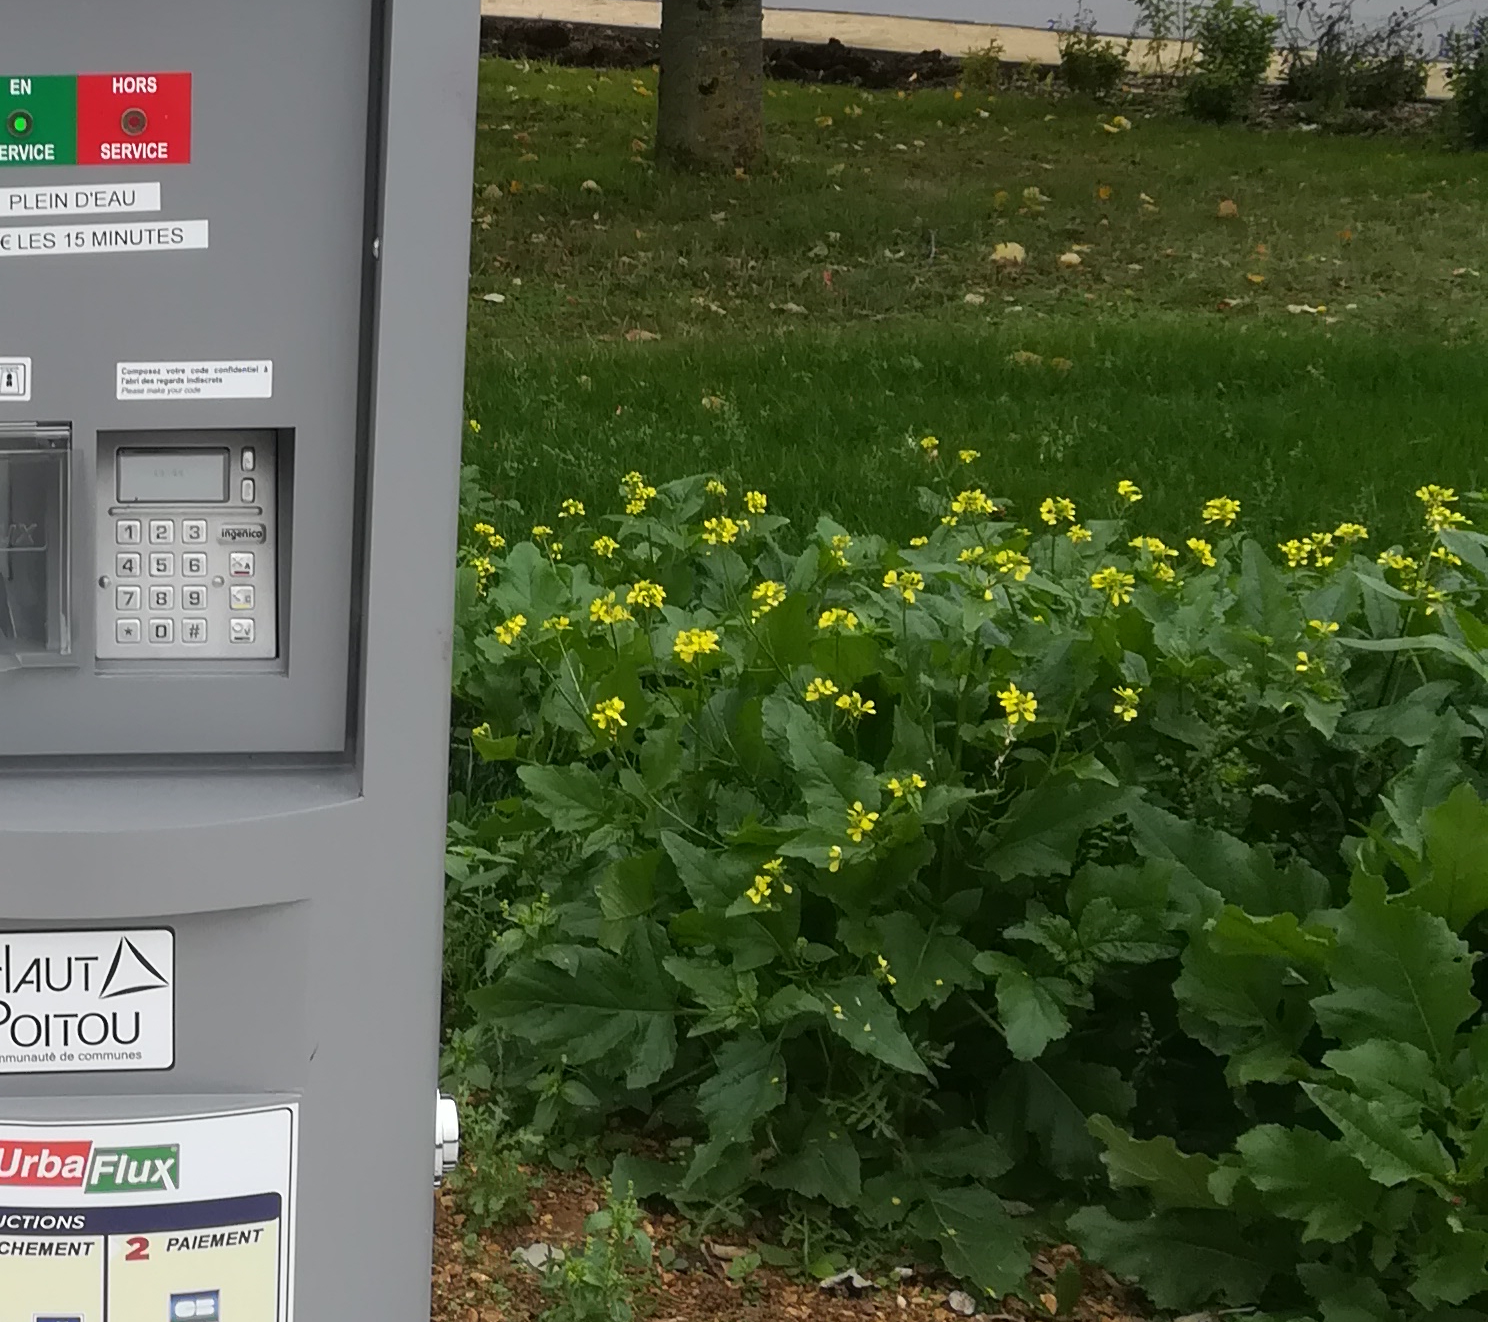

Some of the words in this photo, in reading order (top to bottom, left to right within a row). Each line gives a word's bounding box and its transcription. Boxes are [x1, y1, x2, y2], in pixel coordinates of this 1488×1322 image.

[10, 78, 31, 95] EN
[112, 77, 157, 94] HORS
[100, 142, 168, 160] SERVICE
[9, 192, 68, 210] PLEIN
[76, 190, 136, 208] D'EAU
[0, 234, 12, 251] €
[18, 232, 56, 250] LES
[64, 231, 85, 248] 15
[92, 227, 184, 247] MINUTES
[121, 367, 161, 375] Composez
[191, 366, 209, 374] code
[214, 365, 259, 374] confidentiel
[141, 377, 155, 385] des
[156, 377, 184, 386] regards
[186, 376, 223, 384] indiscrets
[124, 525, 133, 540] 1
[156, 525, 167, 540] 2
[189, 525, 200, 540] 3
[221, 528, 262, 540] ingenico
[122, 558, 133, 573] 4
[156, 558, 167, 573] 5
[189, 558, 200, 573] 6
[123, 591, 134, 606] 7
[156, 591, 167, 606] 8
[189, 591, 200, 606] 9
[155, 624, 167, 638] 0
[188, 624, 200, 638] #
[60, 1051, 74, 1062] de
[78, 1051, 142, 1062] communes
[125, 1236, 150, 1261] 2
[166, 1228, 264, 1252] PAIEMENT
